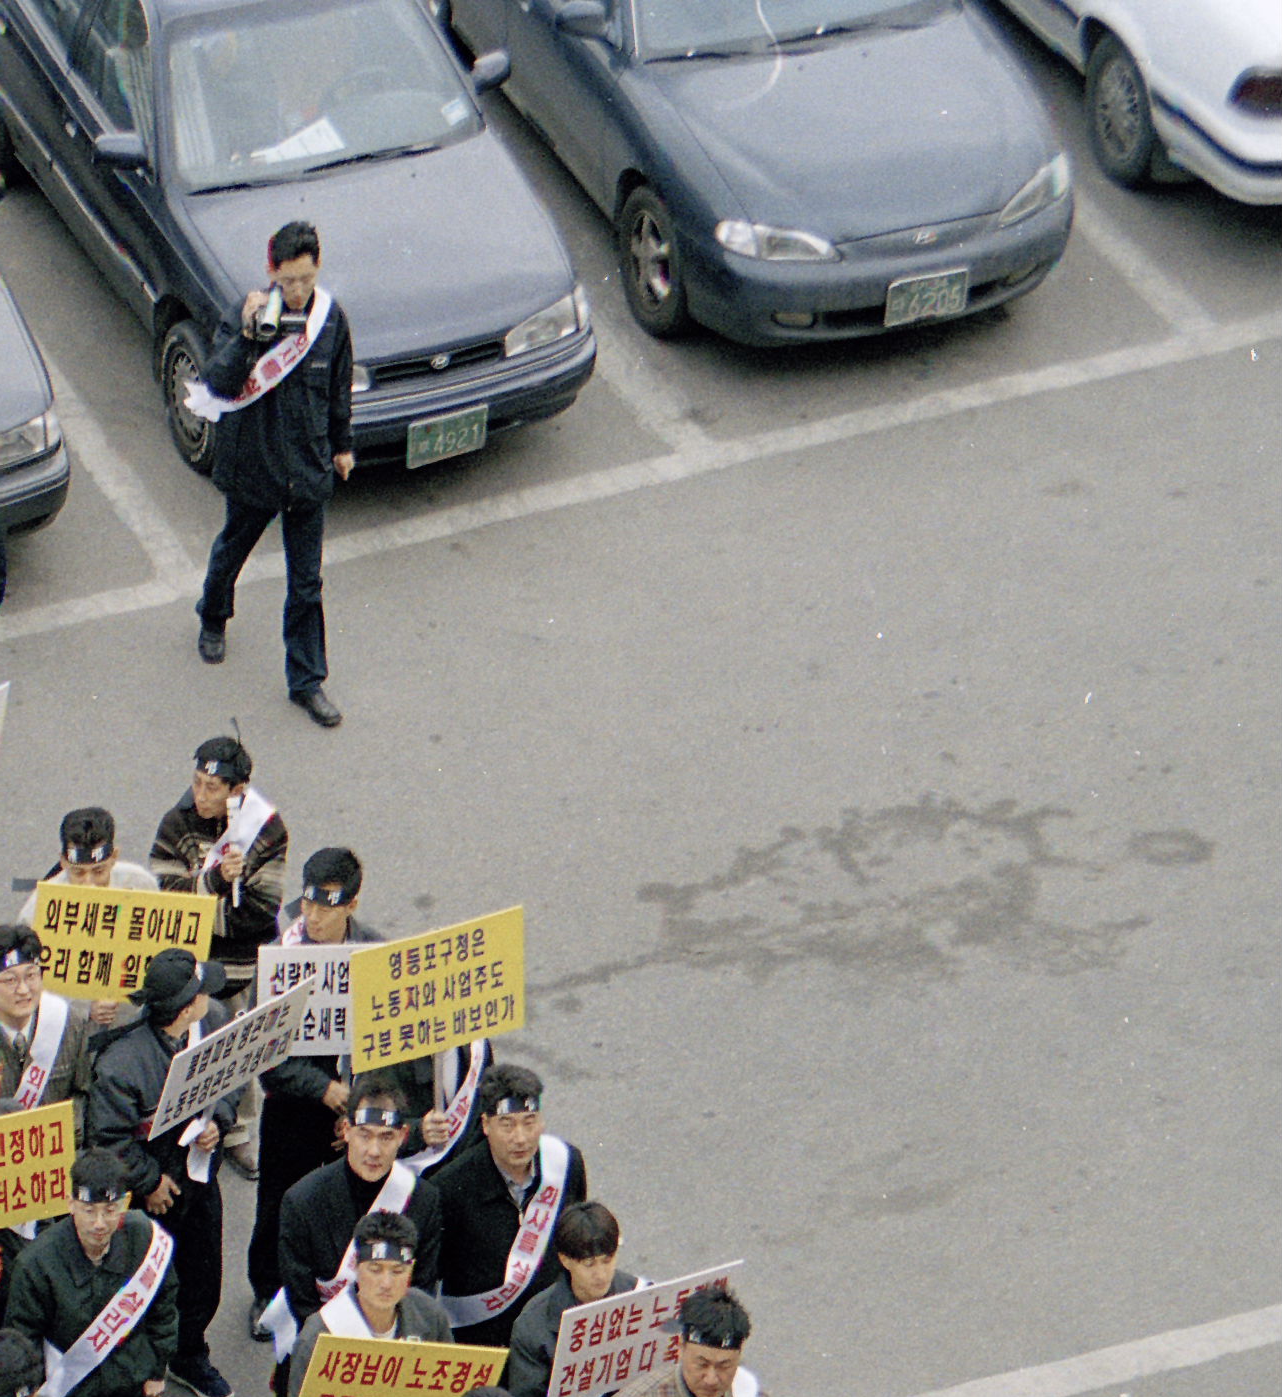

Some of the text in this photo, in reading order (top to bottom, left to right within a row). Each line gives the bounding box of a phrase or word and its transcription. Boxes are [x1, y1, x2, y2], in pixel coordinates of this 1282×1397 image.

[44, 899, 201, 945] 외부세력 몰아내고
[389, 928, 485, 980] 영등포구청은
[372, 961, 503, 1021] 노동자와 사업주도
[363, 994, 515, 1060] 구분 못하는 바보인가
[570, 1304, 642, 1352] 중심없는
[318, 1352, 403, 1387] 사장님이
[559, 1340, 657, 1397] 건설기업 다
